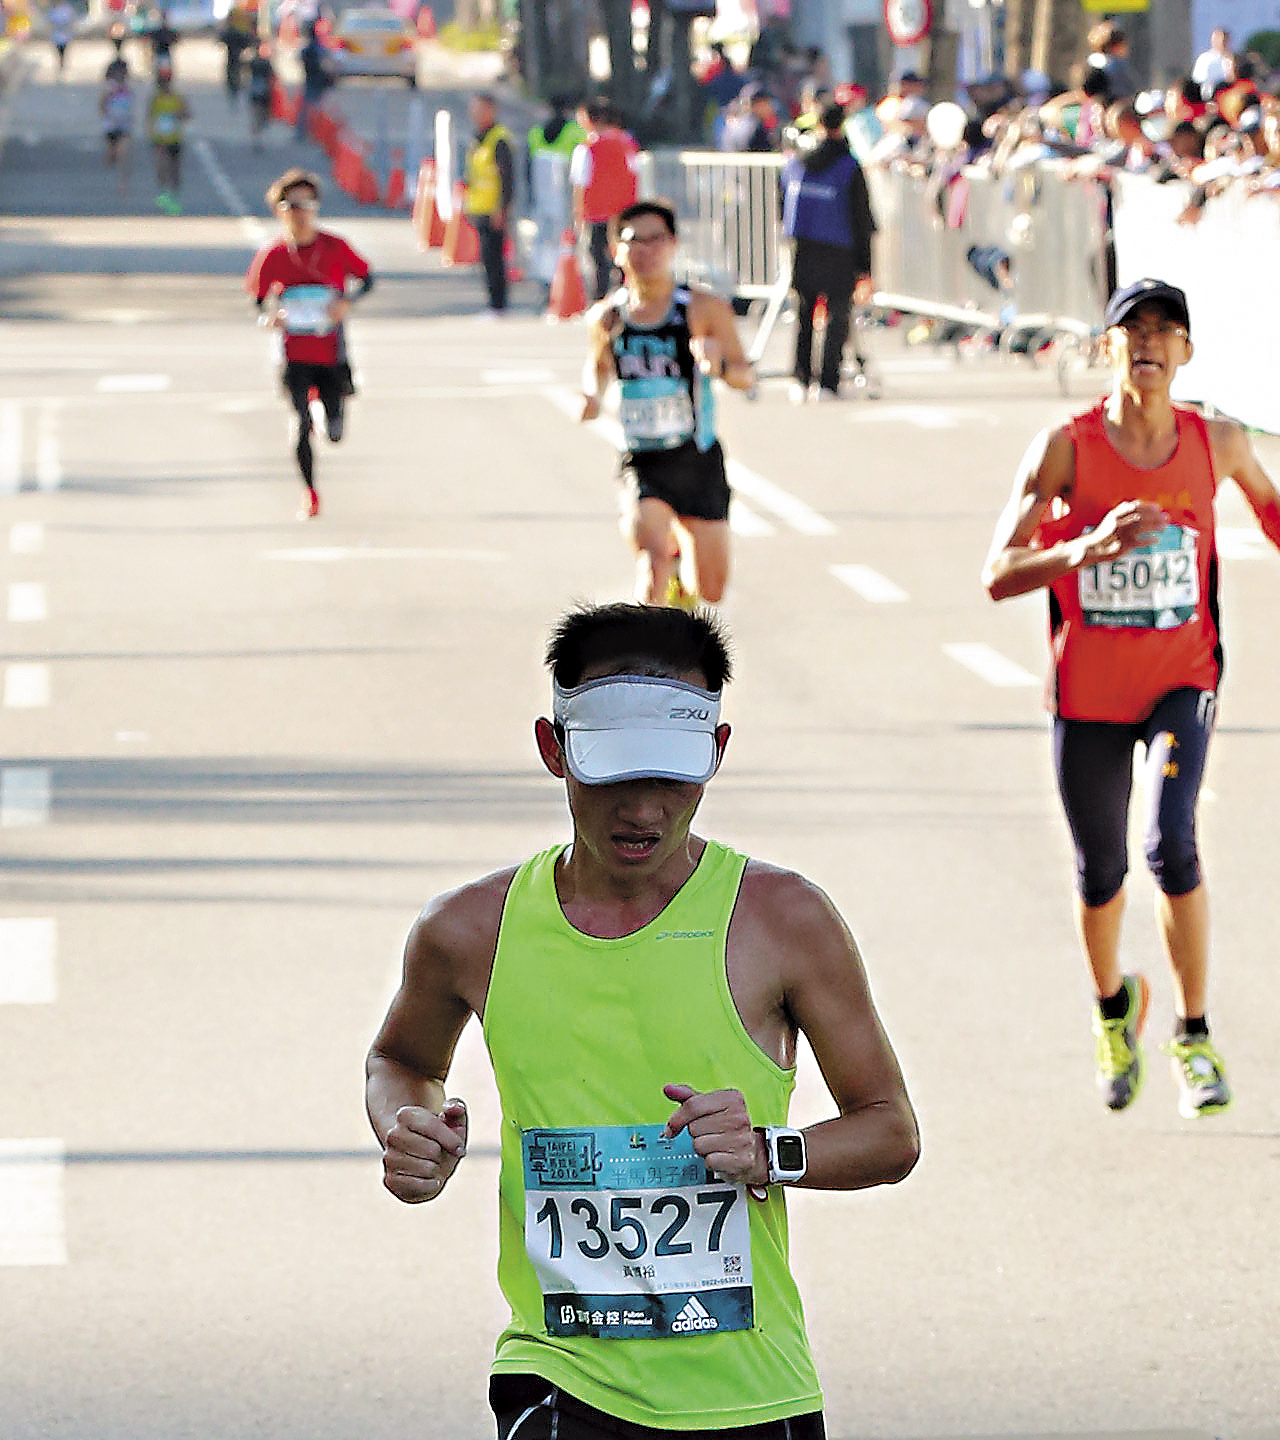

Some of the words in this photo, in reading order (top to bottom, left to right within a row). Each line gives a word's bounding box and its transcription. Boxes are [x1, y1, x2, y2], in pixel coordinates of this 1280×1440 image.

[1086, 556, 1191, 591] 15042
[669, 708, 710, 721] 2XU
[551, 1168, 578, 1179] 2016
[537, 1190, 738, 1260] 13527
[672, 1316, 719, 1334] adidas
